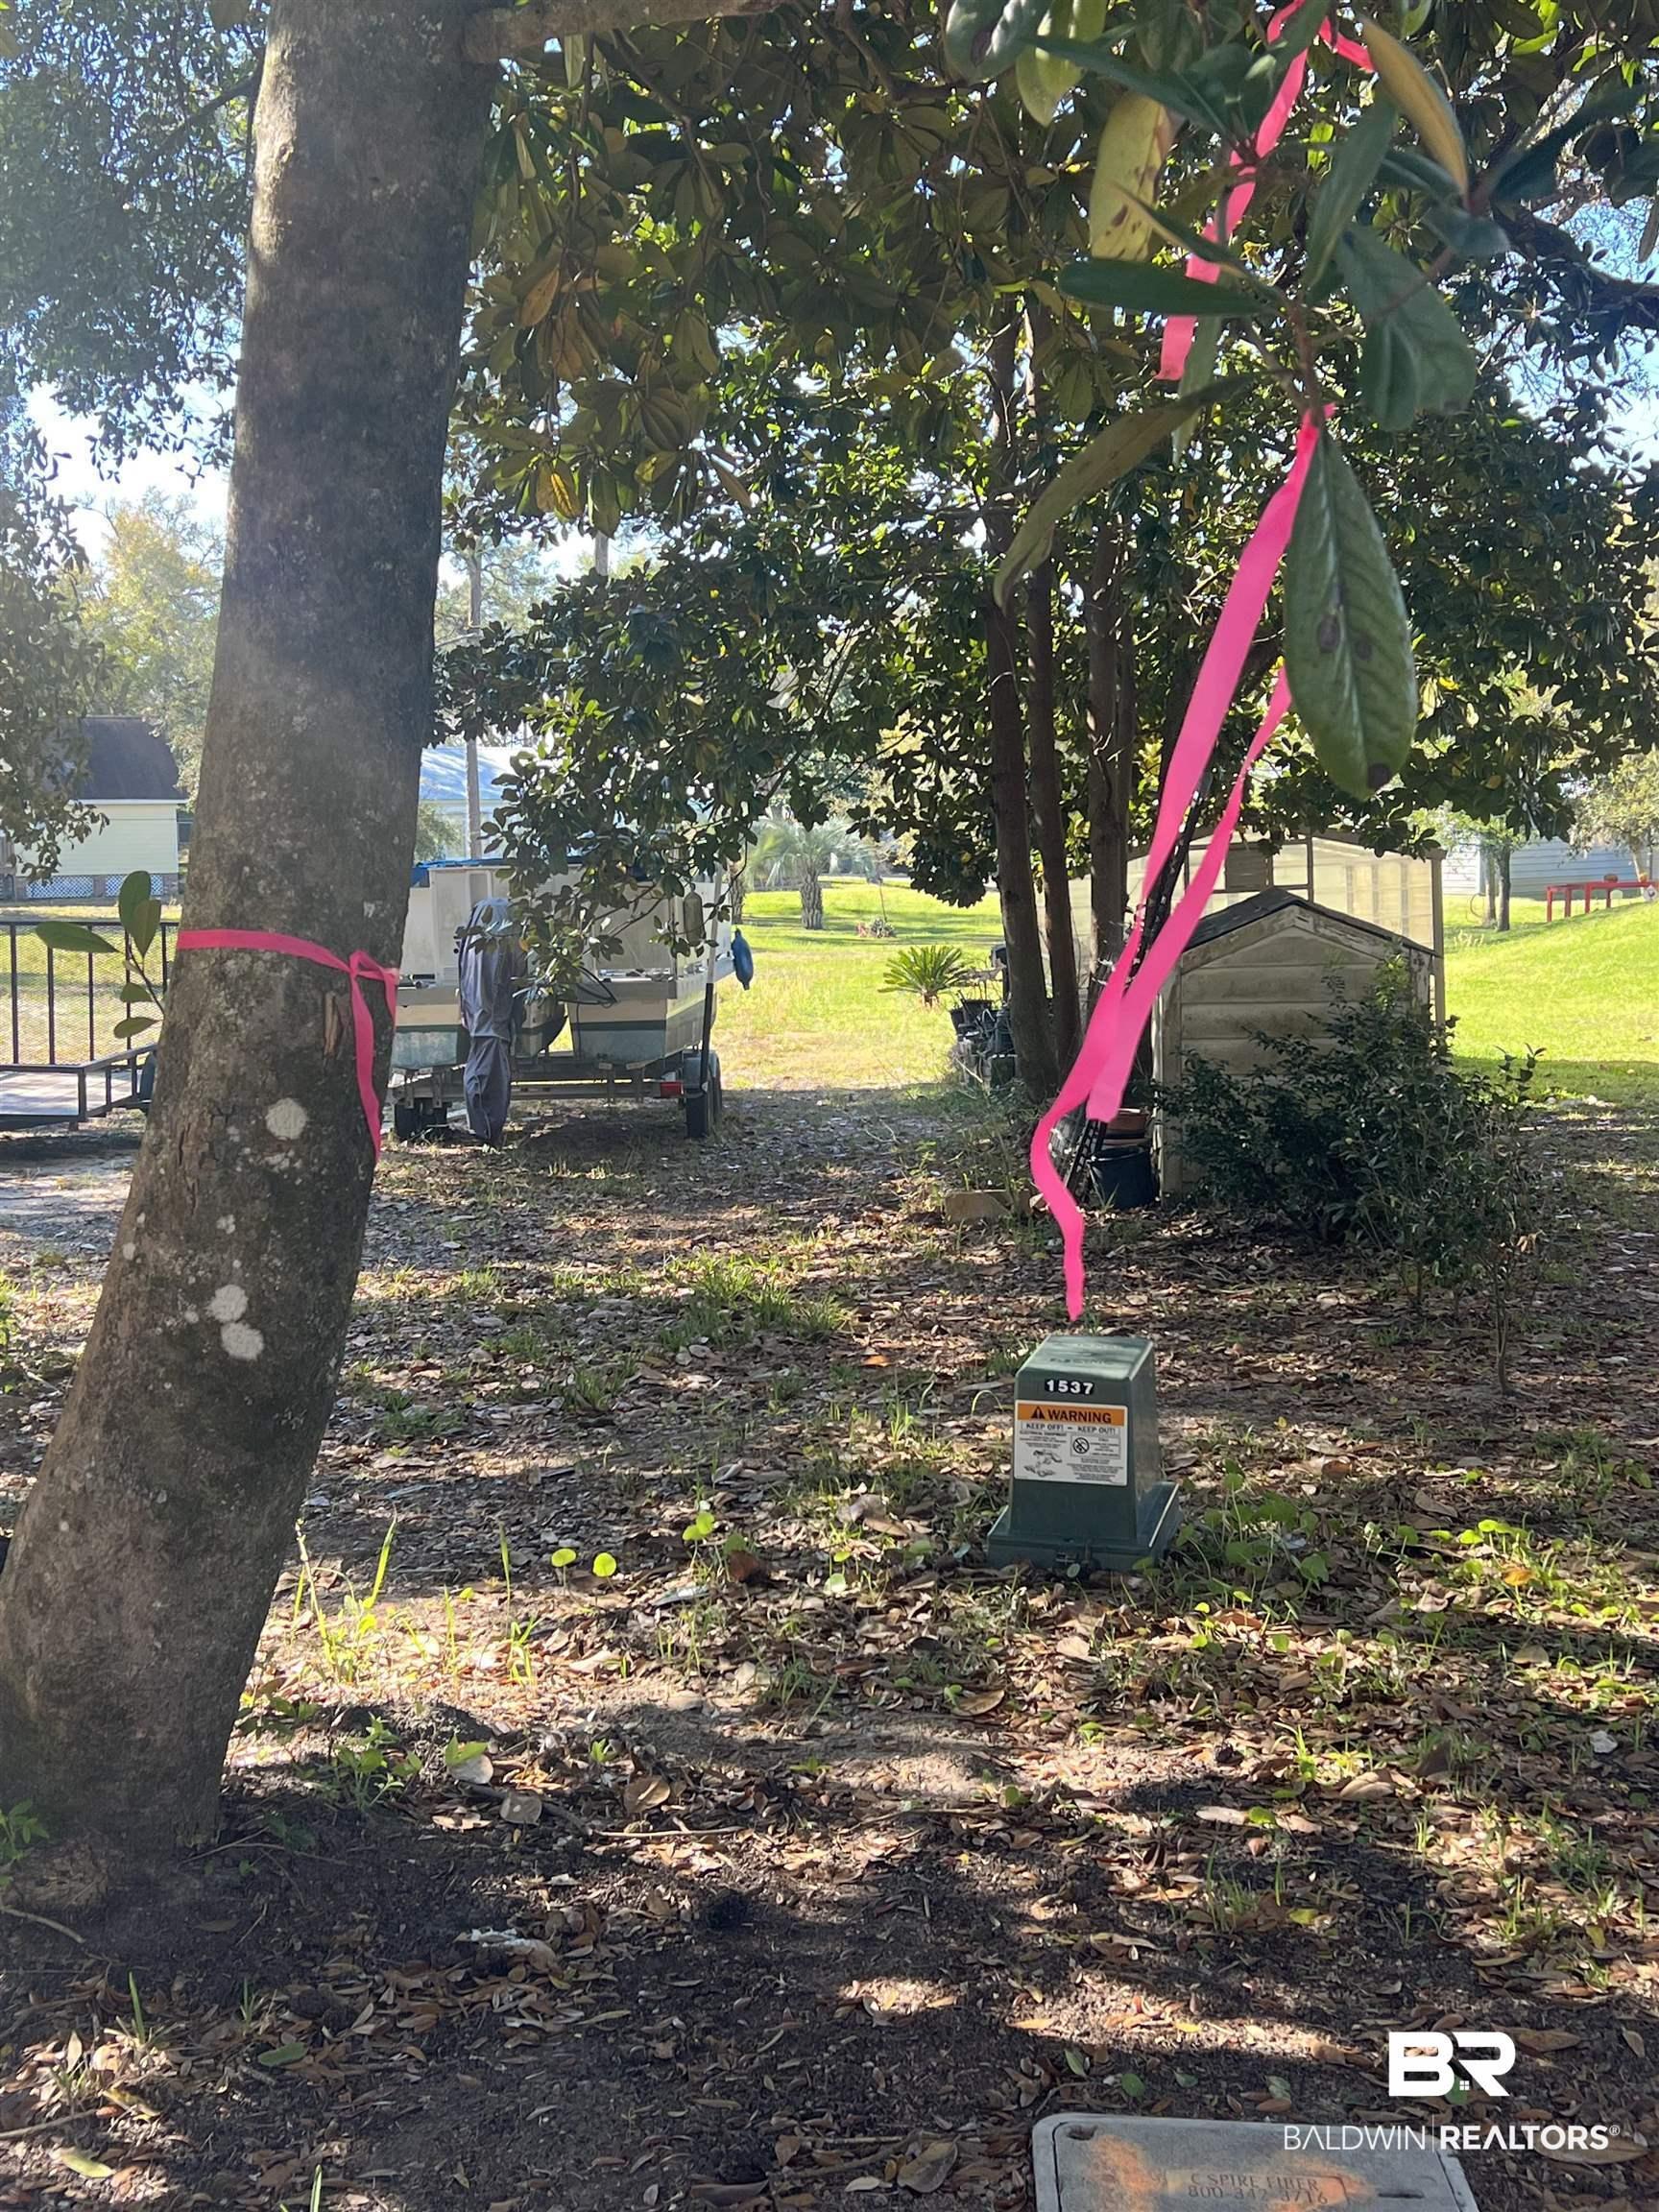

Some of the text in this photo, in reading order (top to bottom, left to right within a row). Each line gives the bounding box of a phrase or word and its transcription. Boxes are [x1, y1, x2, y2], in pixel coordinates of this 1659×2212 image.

[1046, 1380, 1094, 1394] 1537
[1047, 1409, 1112, 1424] WARNING
[1207, 2173, 1259, 2189] SPIRE
[1266, 2176, 1319, 2192] FIBER
